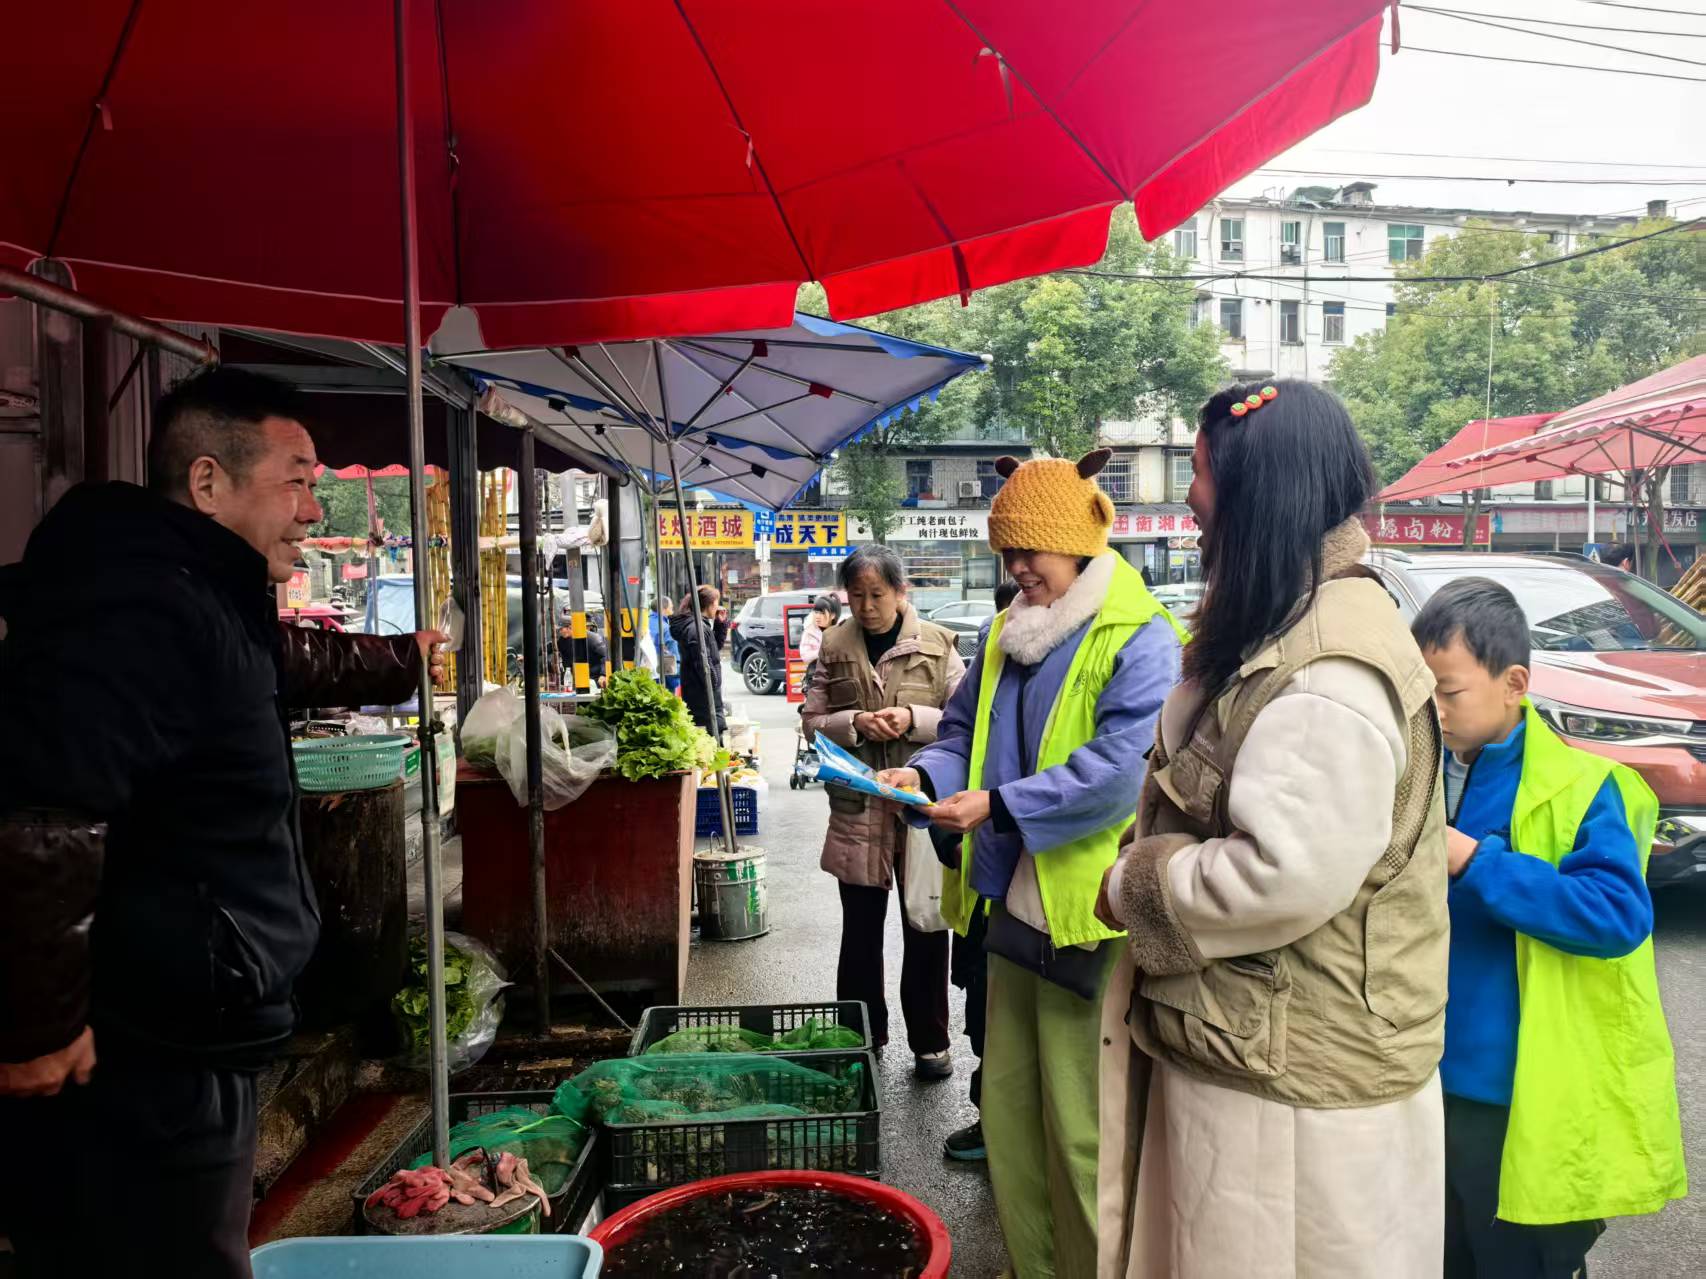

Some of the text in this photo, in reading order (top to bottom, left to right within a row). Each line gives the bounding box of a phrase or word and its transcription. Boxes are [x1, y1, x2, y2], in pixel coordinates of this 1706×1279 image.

[754, 524, 839, 544] 成天下
[918, 528, 979, 539] 肉汁现包鲜饺
